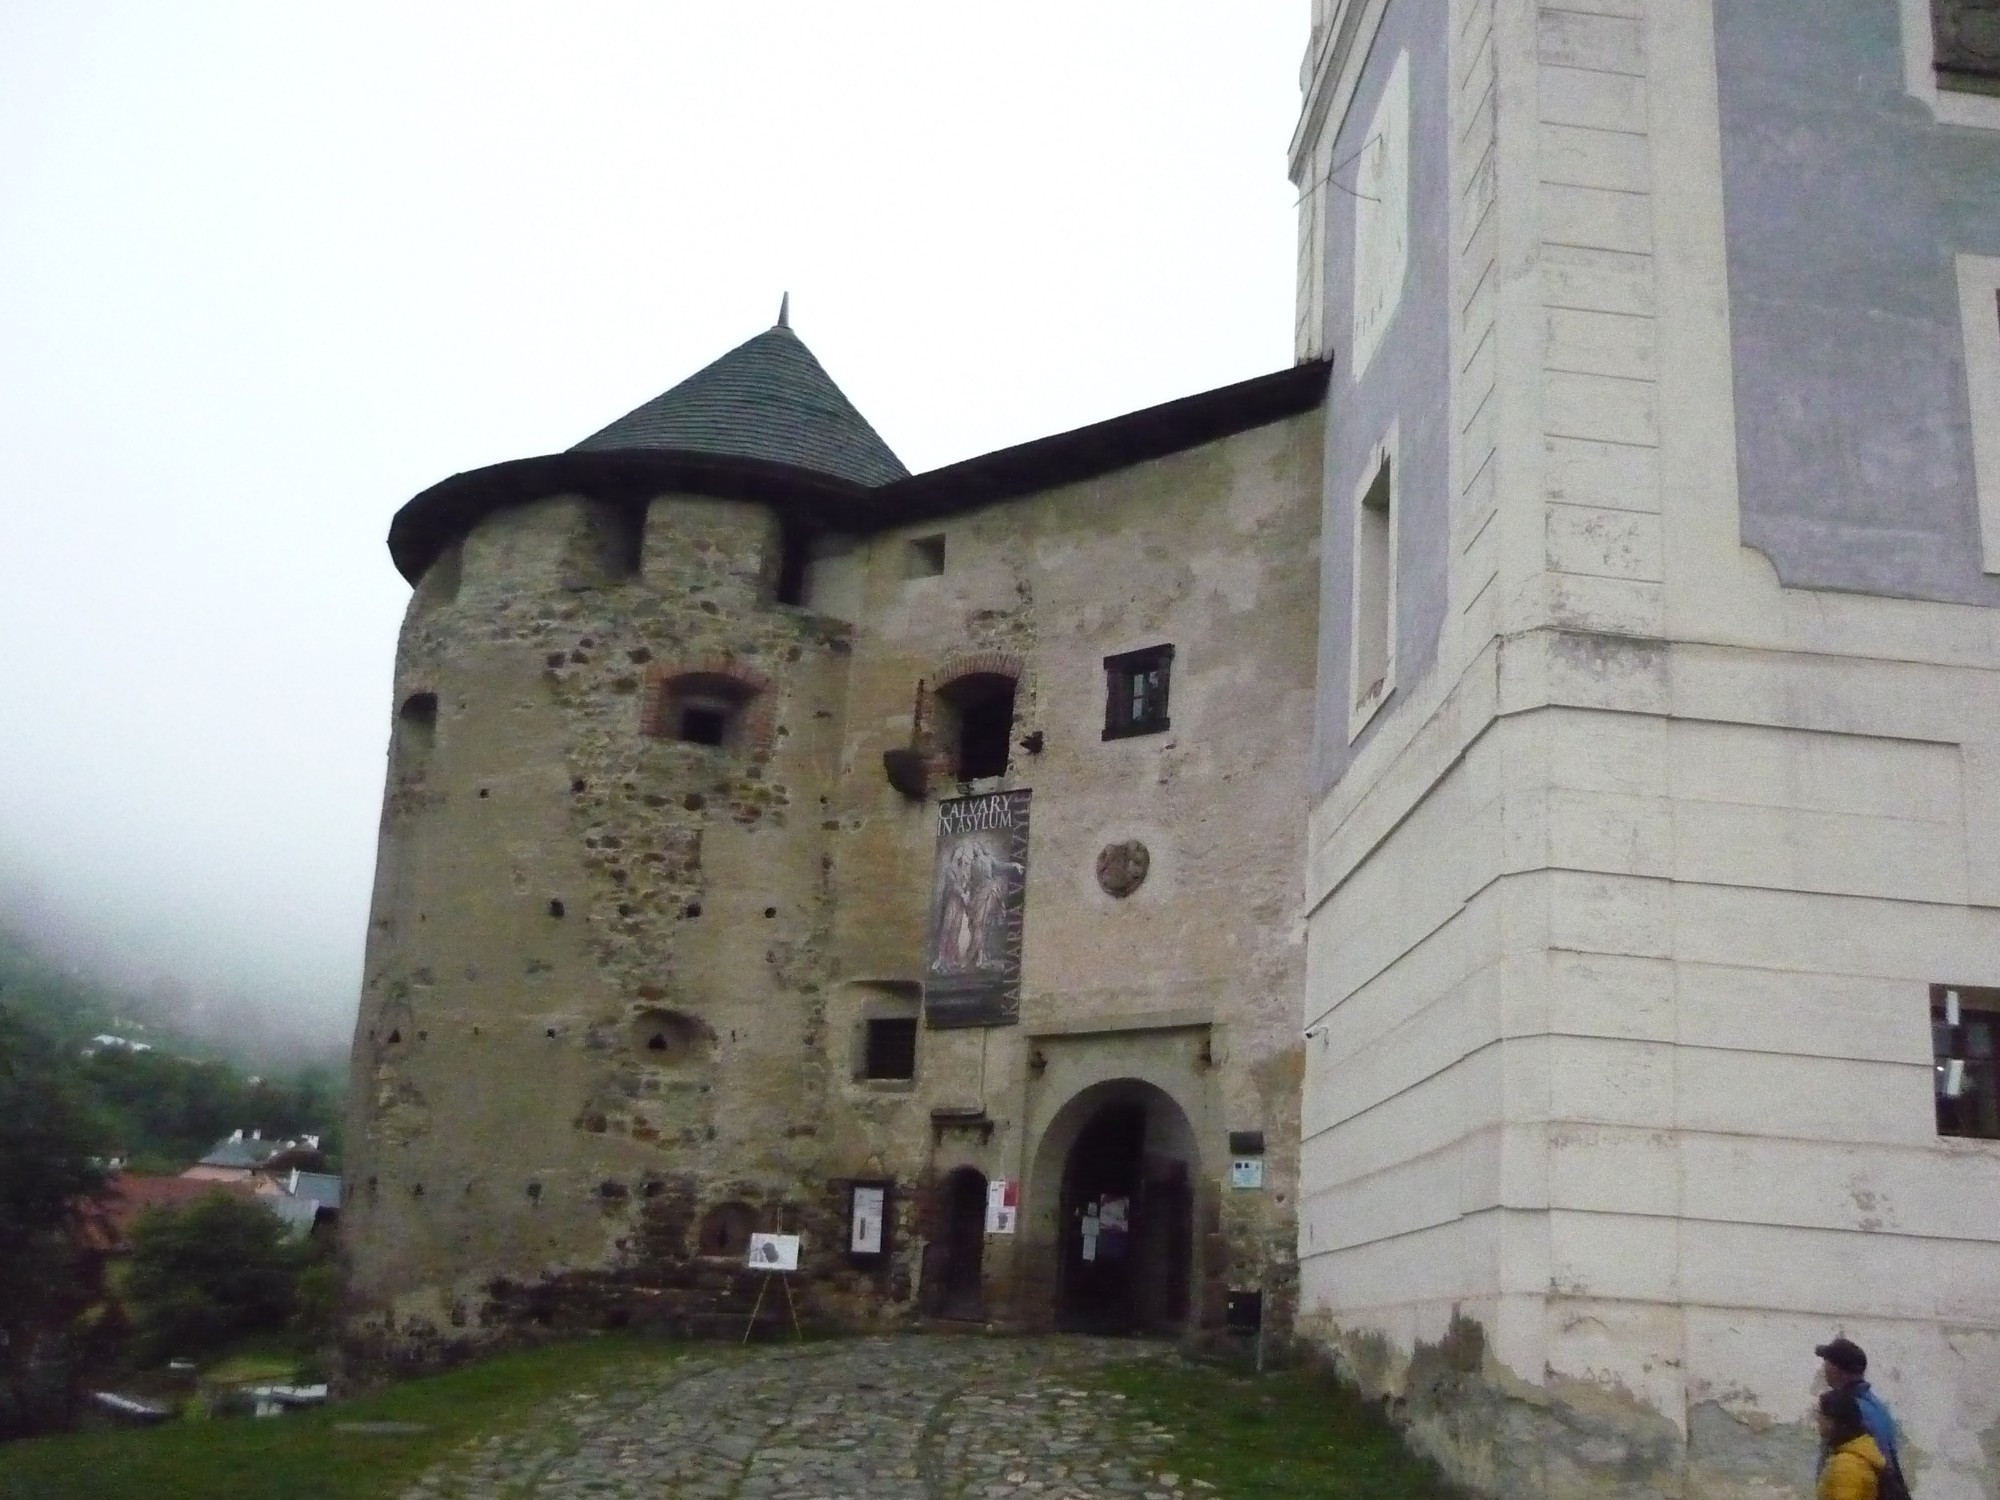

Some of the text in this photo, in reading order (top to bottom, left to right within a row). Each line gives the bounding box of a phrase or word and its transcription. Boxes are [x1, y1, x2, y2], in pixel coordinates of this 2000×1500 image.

[939, 794, 1013, 820] CALVARY
[937, 809, 1012, 836] IN ASYLUM
